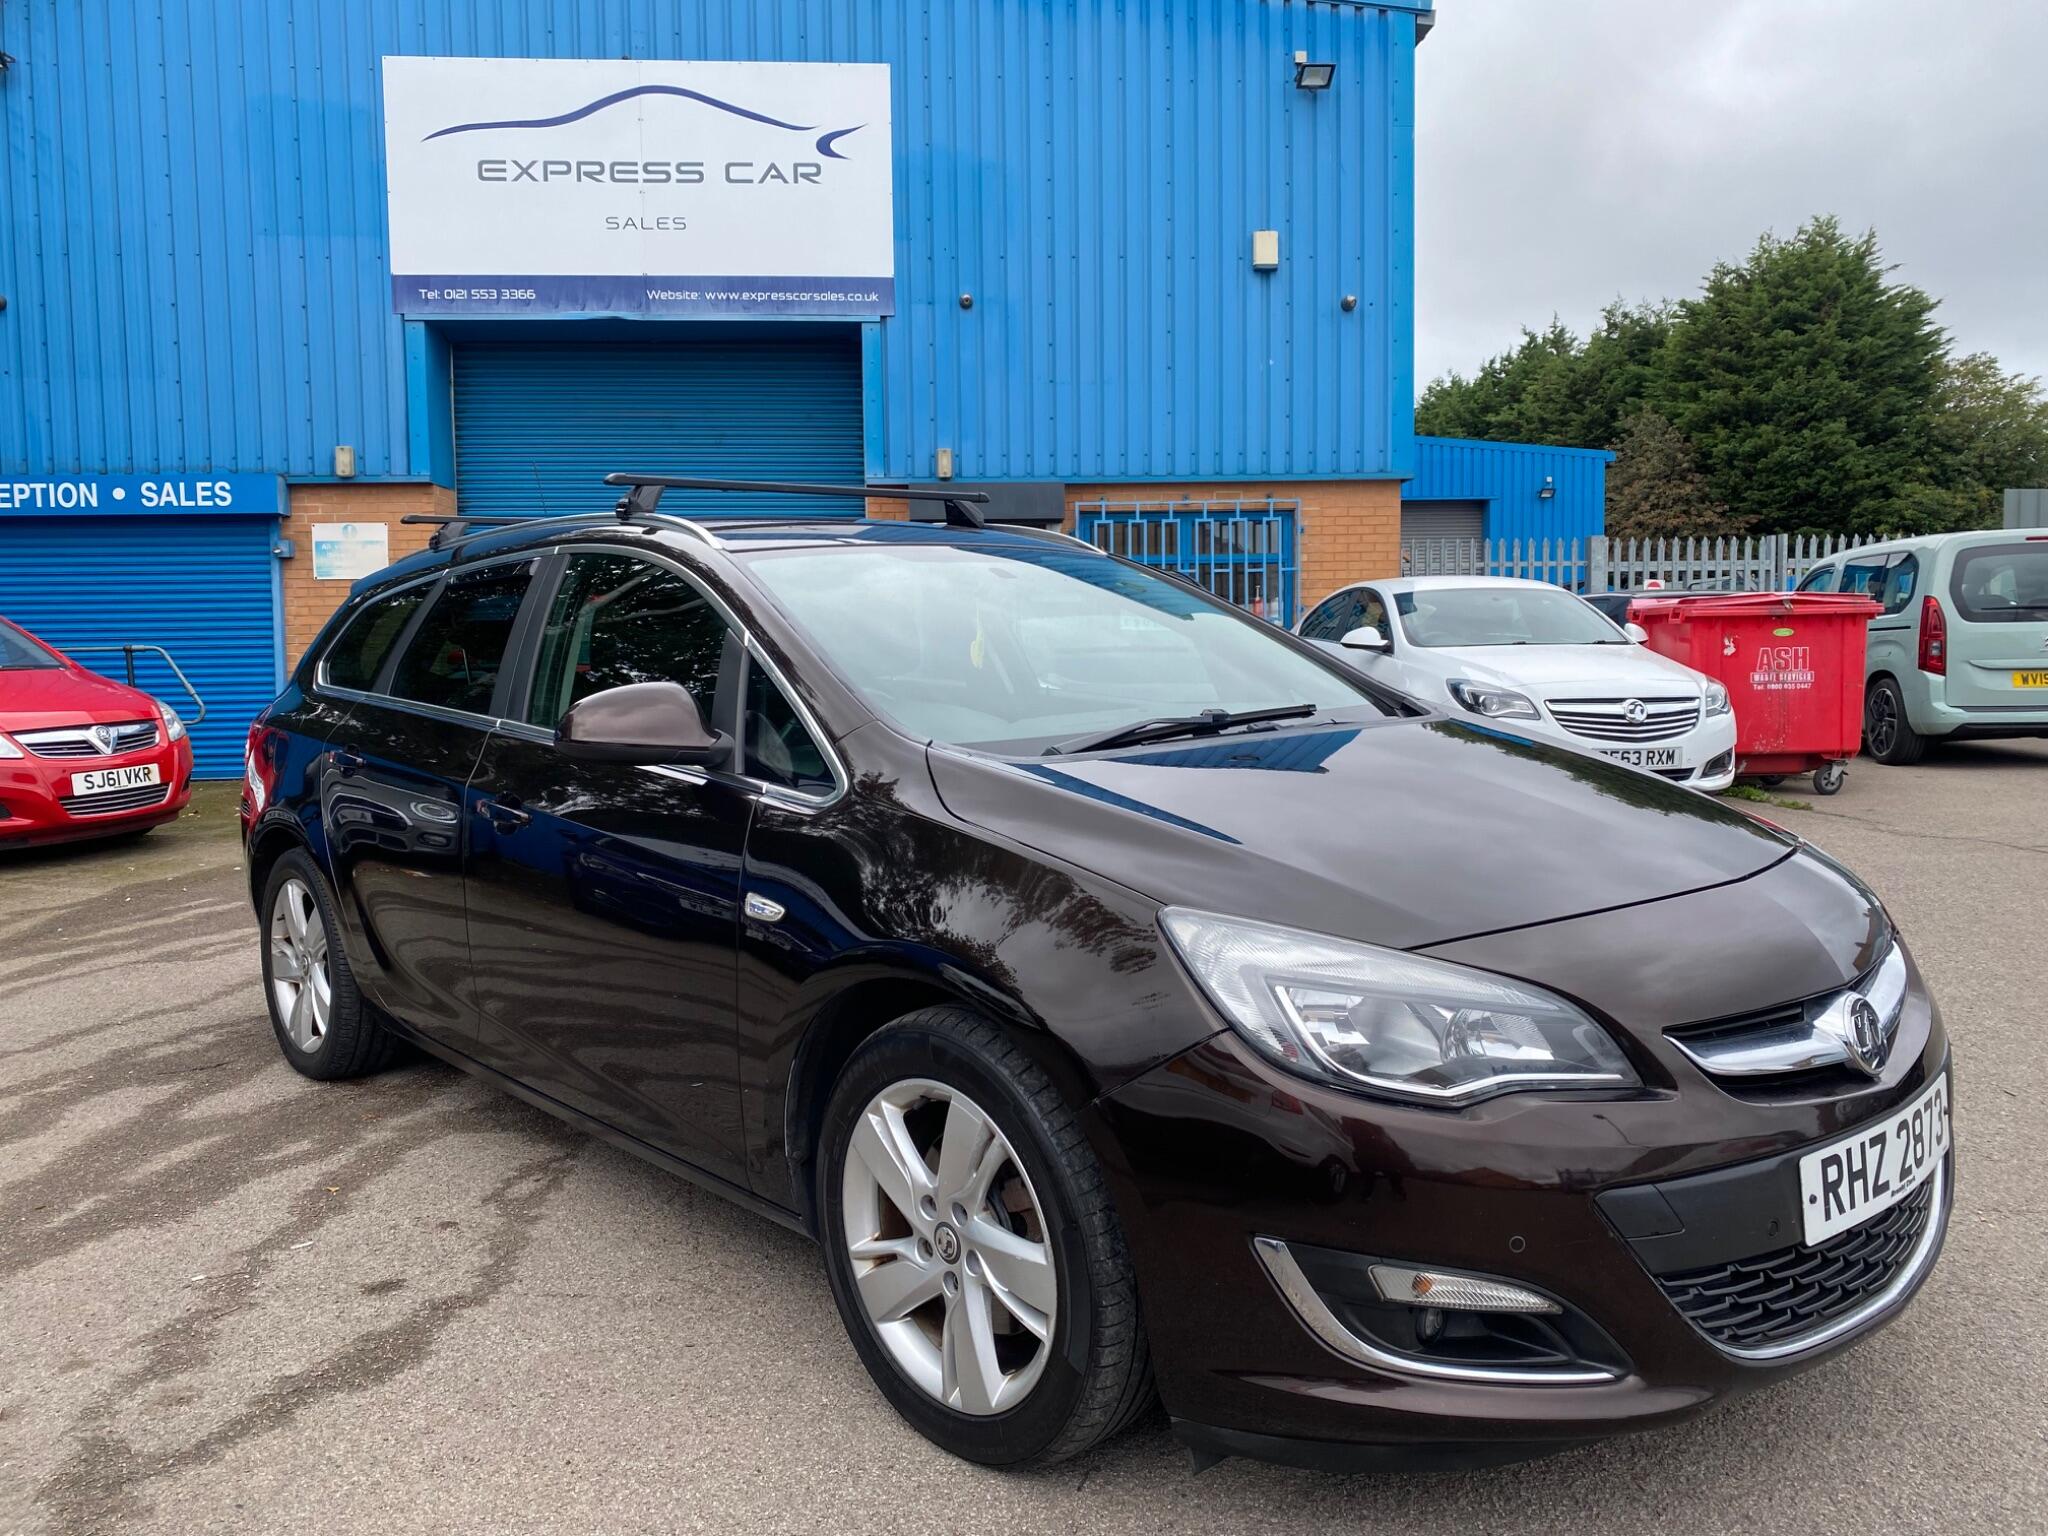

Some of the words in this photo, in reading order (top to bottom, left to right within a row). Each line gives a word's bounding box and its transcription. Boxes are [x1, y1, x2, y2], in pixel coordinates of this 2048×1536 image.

[477, 159, 705, 184] EXPRESS
[724, 162, 822, 185] CAR
[605, 216, 687, 231] SALES
[418, 288, 441, 300] Tel:
[444, 289, 468, 300] 0121
[471, 289, 498, 300] 553
[501, 289, 537, 300] 3366
[646, 289, 701, 301] Website:
[704, 290, 880, 302] www.expresscarsales.co.uk
[141, 481, 233, 508] SALES
[1756, 646, 1810, 672] ASH
[1646, 749, 1676, 766] RXM
[84, 770, 121, 790] SJ61
[124, 766, 152, 785] VKR
[1821, 1131, 1890, 1222] RHZ
[1896, 1088, 1943, 1184] 2873
